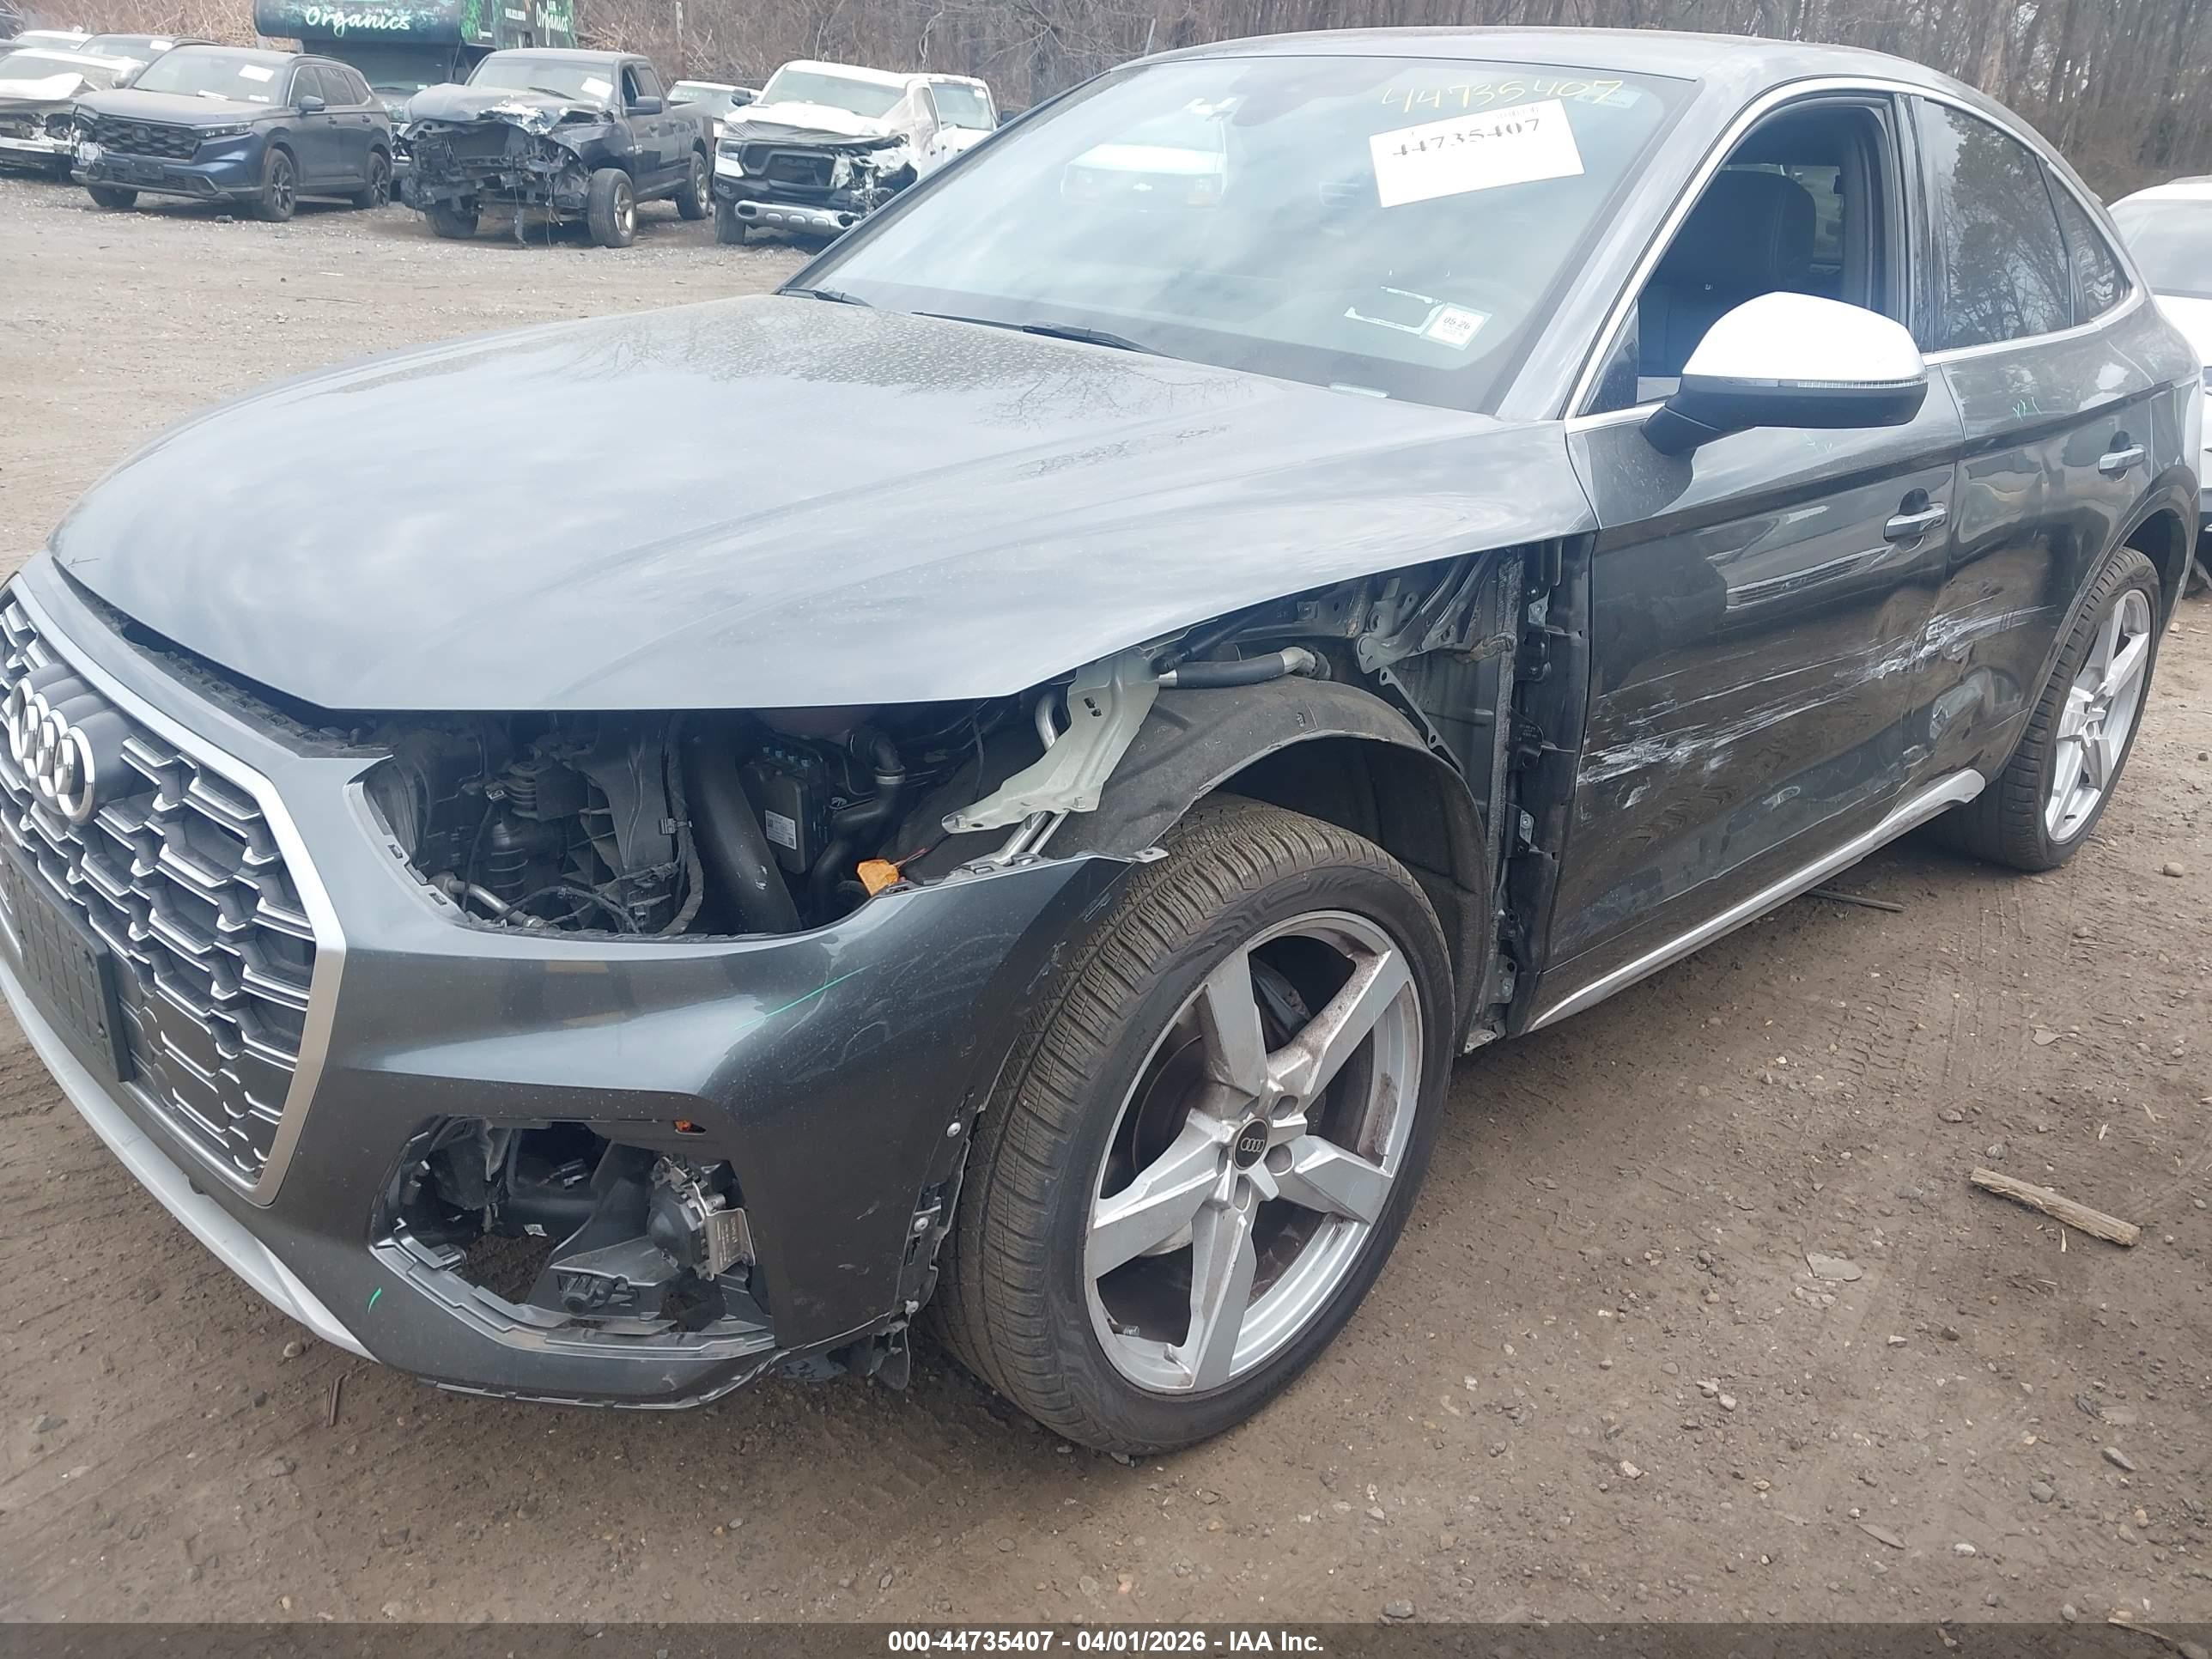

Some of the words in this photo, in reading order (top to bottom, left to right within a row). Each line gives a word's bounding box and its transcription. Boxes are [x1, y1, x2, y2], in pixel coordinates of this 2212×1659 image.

[305, 5, 411, 38] Organics
[536, 1, 569, 47] Organics
[1382, 80, 1624, 112] 44735407
